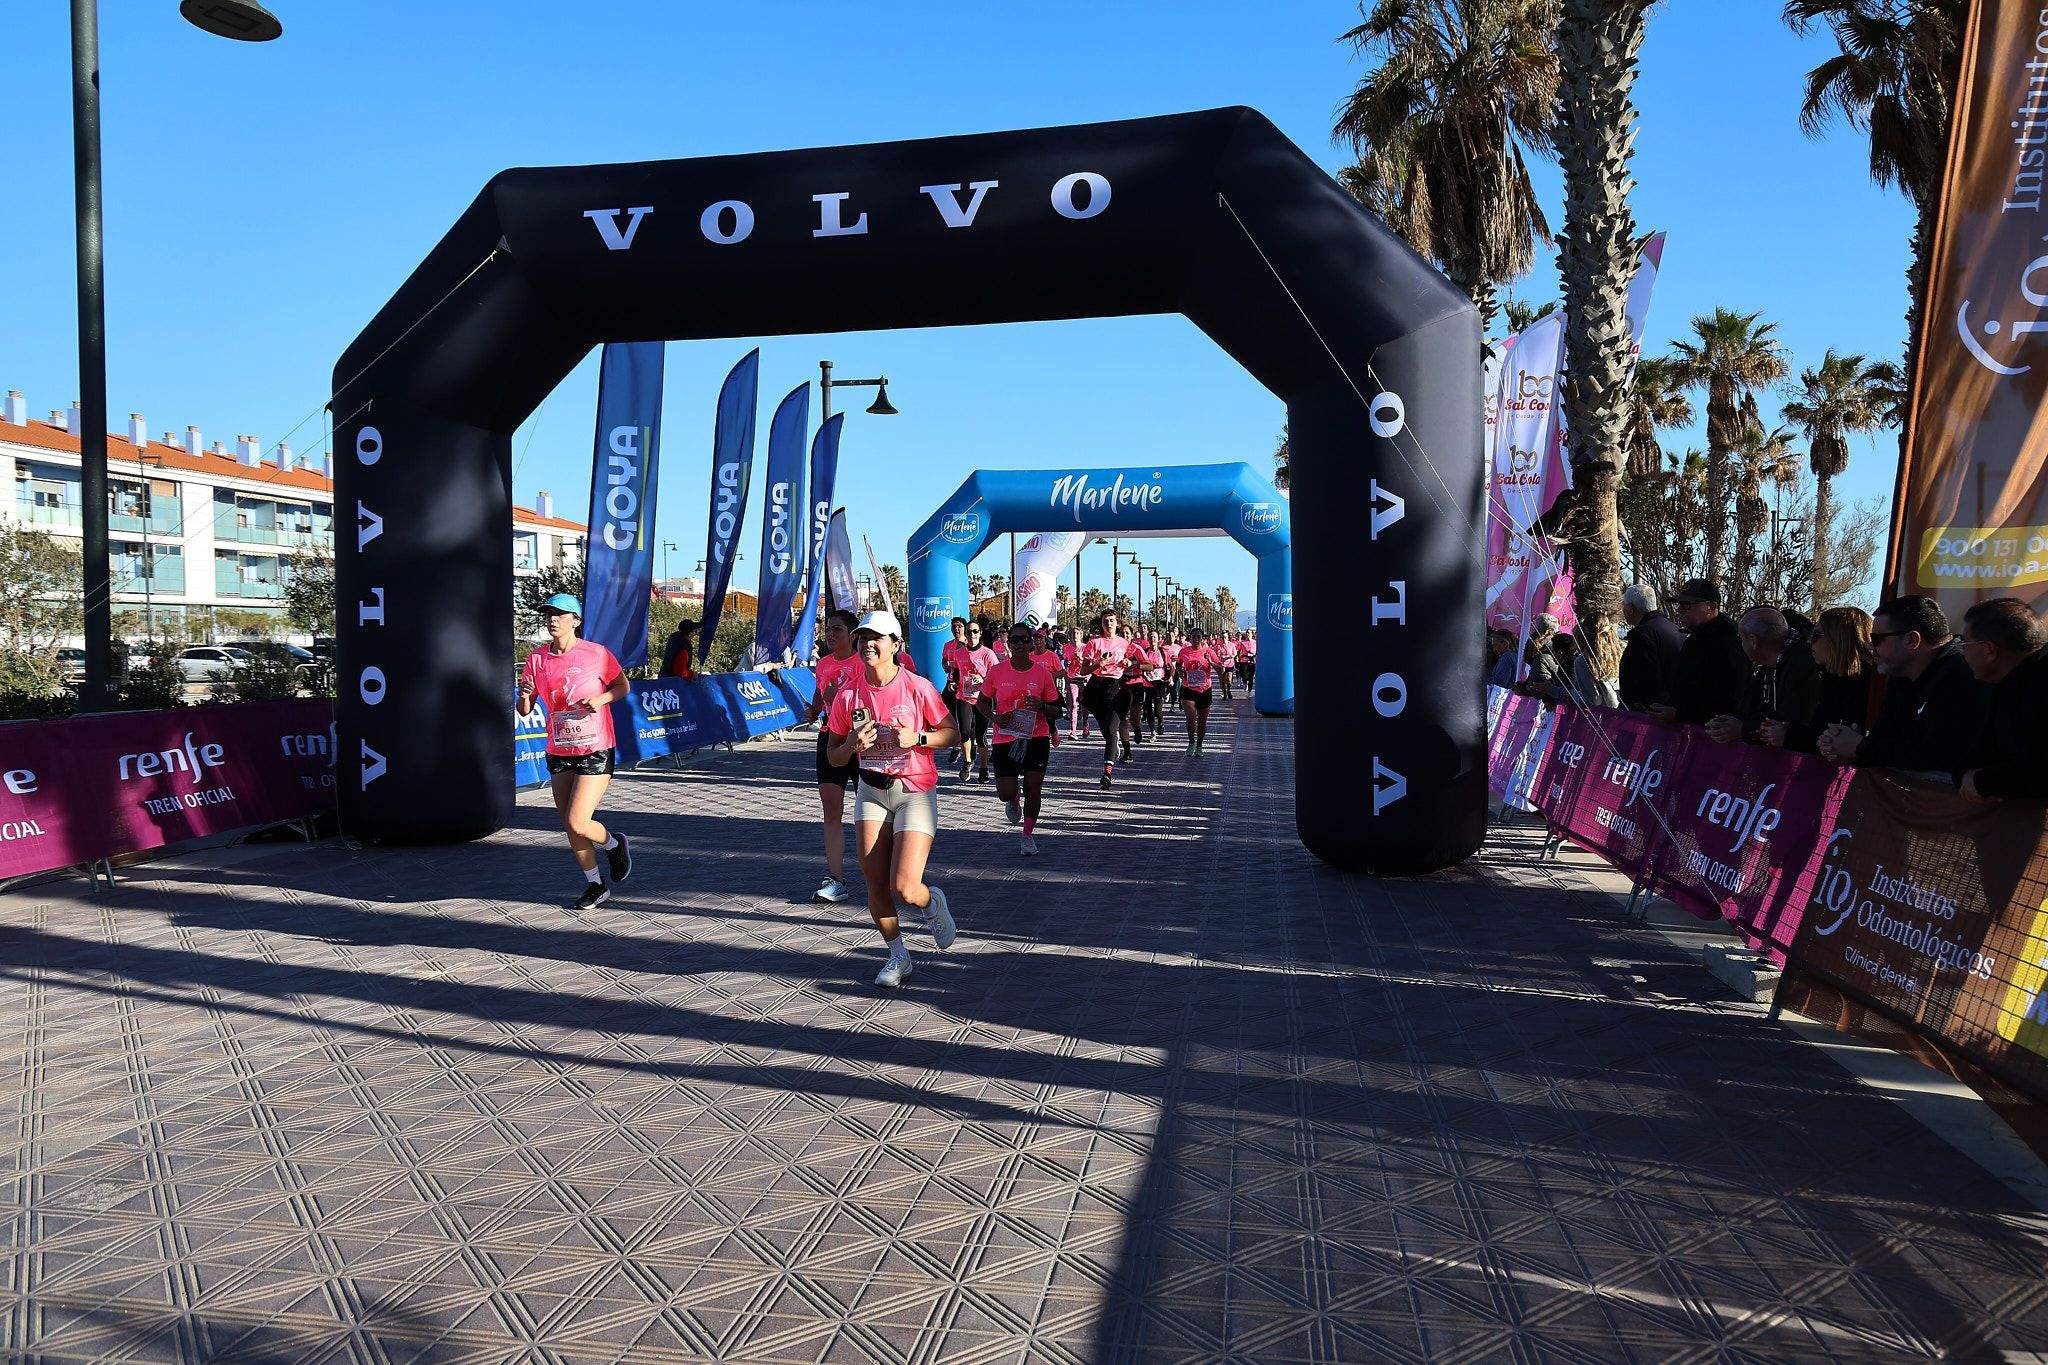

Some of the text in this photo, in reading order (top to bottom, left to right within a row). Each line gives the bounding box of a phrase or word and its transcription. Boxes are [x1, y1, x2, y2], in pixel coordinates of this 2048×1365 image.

[583, 172, 1112, 250] VOLVO
[604, 425, 638, 551] GOYA
[1050, 473, 1162, 523] Marlene
[769, 482, 791, 575] GOYA
[1935, 538, 1988, 557] 900
[356, 426, 387, 791] VOLVO
[1369, 391, 1407, 816] VOLVO
[641, 689, 680, 715] GOYA
[117, 731, 225, 784] renfe
[1602, 749, 1663, 807] renfe
[145, 786, 237, 816] TREN OFICIAL
[1696, 783, 1781, 853] renfe
[0, 820, 46, 842] CIAL
[1686, 849, 1710, 877] TREN
[1868, 864, 1958, 920] Institutos
[1857, 900, 1996, 980] Odontológicos
